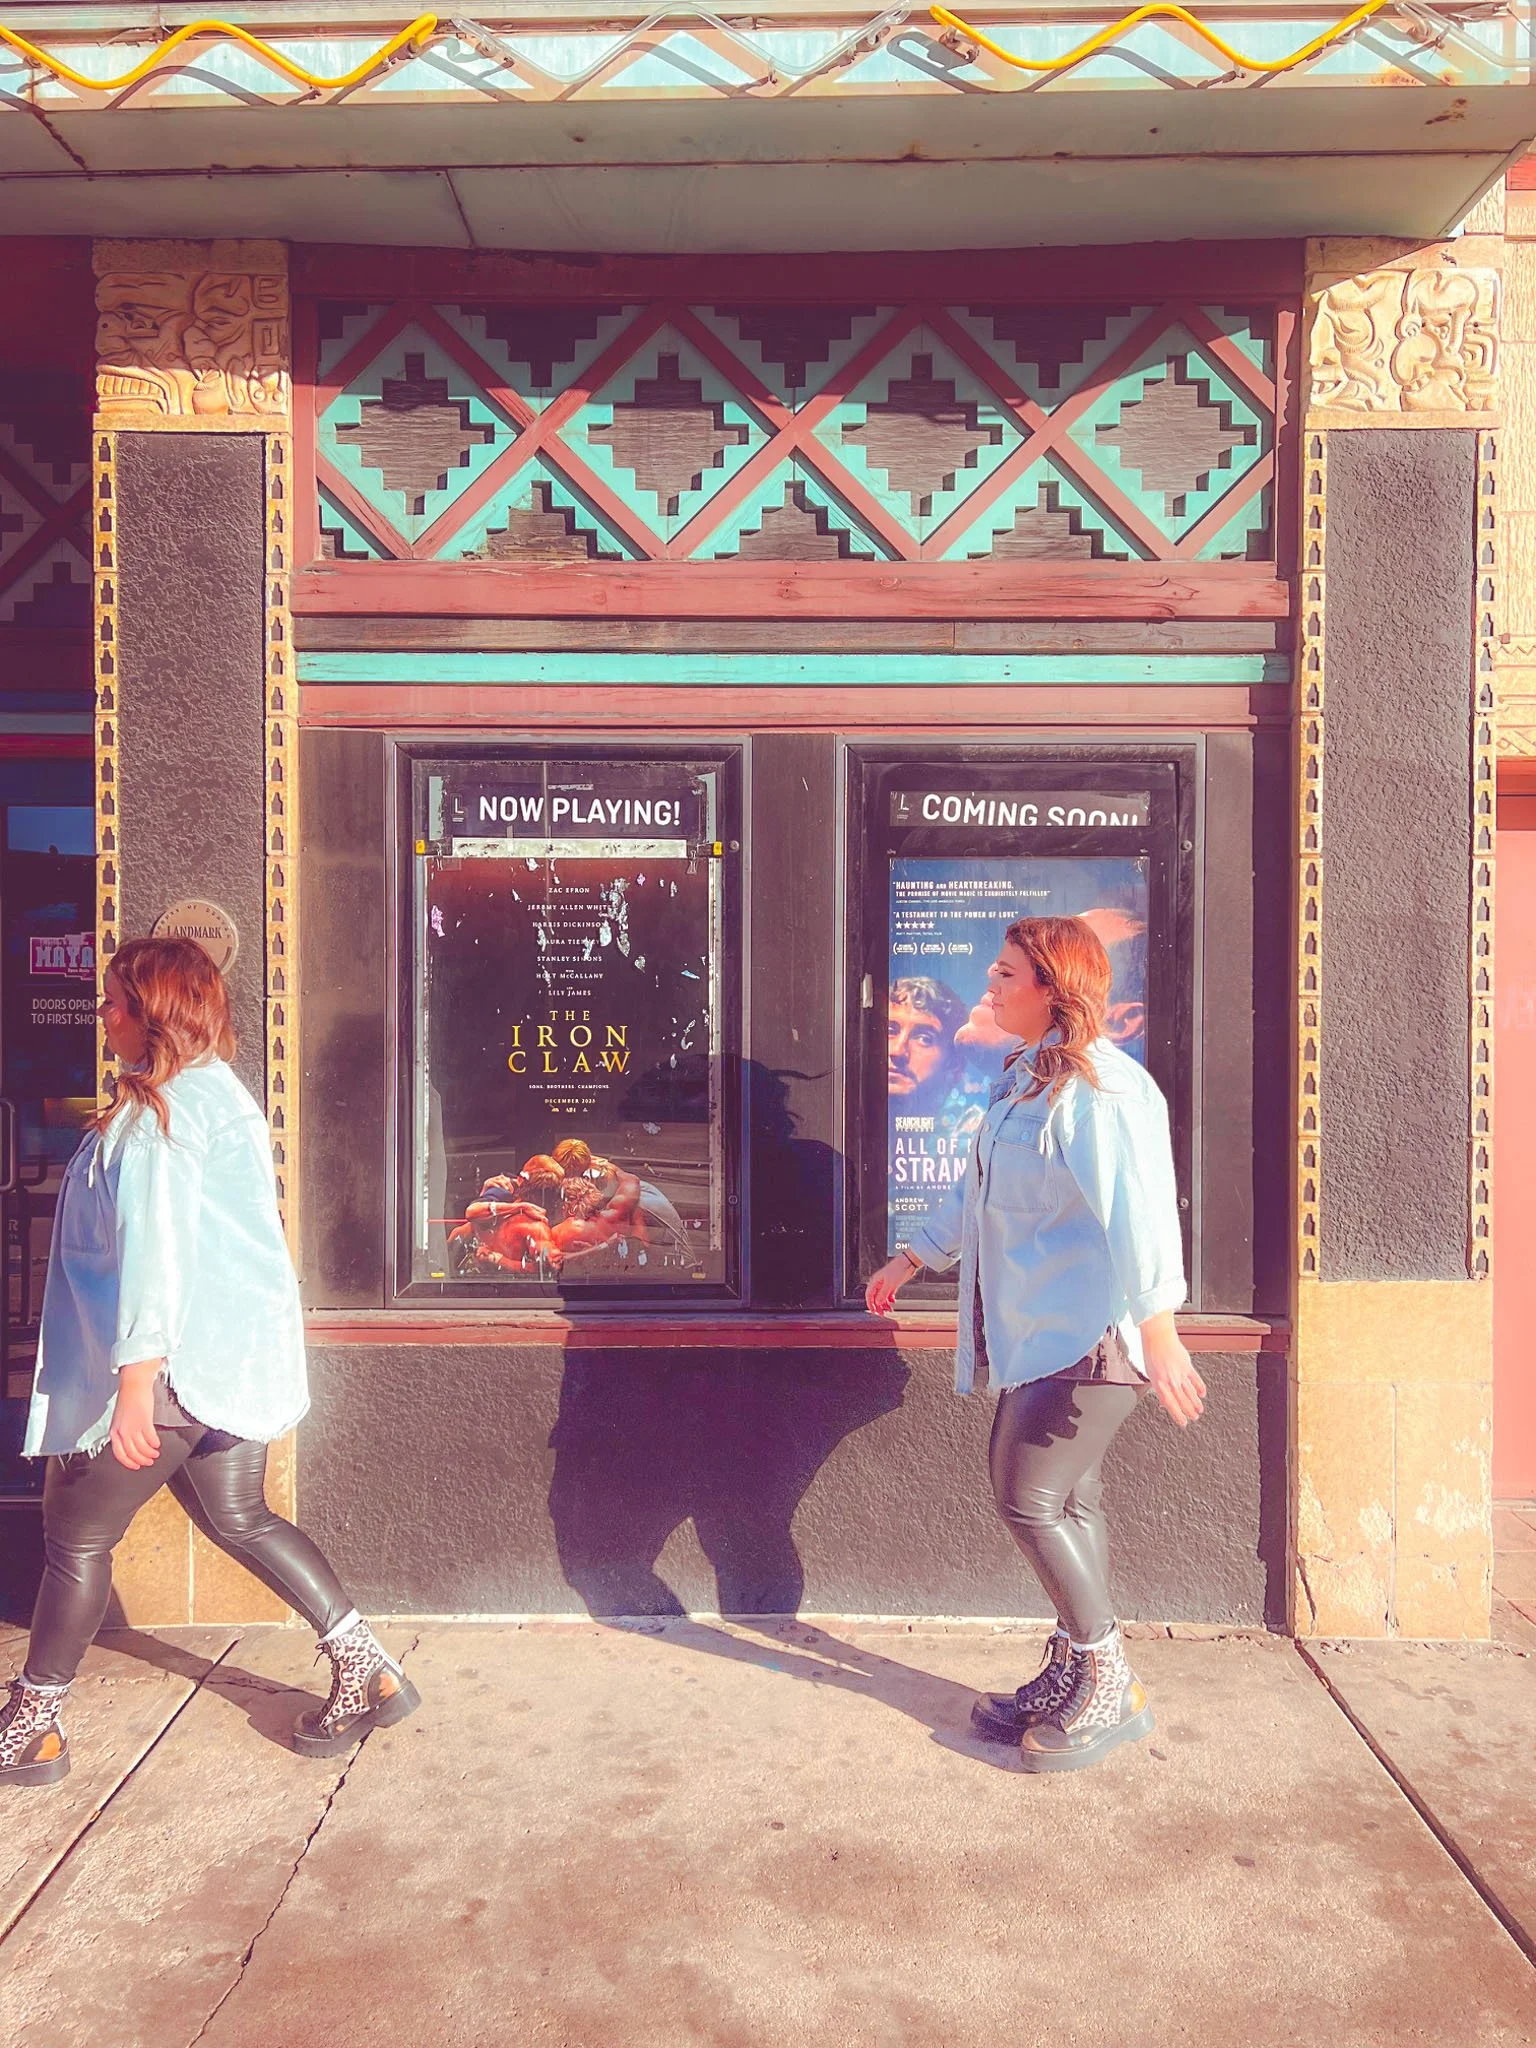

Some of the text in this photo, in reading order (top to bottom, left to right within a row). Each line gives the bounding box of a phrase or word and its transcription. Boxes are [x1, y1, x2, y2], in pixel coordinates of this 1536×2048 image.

[480, 795, 680, 826] NOW PLAYING!
[922, 793, 1039, 826] COMING
[948, 881, 1014, 889] HEARTBREAKING.
[167, 925, 222, 938] LANDMARK
[32, 998, 96, 1011] DOORS OPEN
[31, 1013, 94, 1025] TO FIRST SHO
[549, 1010, 590, 1020] THE
[511, 1025, 628, 1047] IRON
[508, 1051, 631, 1073] CLAW
[895, 1137, 928, 1155] ALL
[937, 1137, 958, 1155] OF
[895, 1156, 967, 1183] STRAN
[895, 1204, 929, 1212] SCOTT
